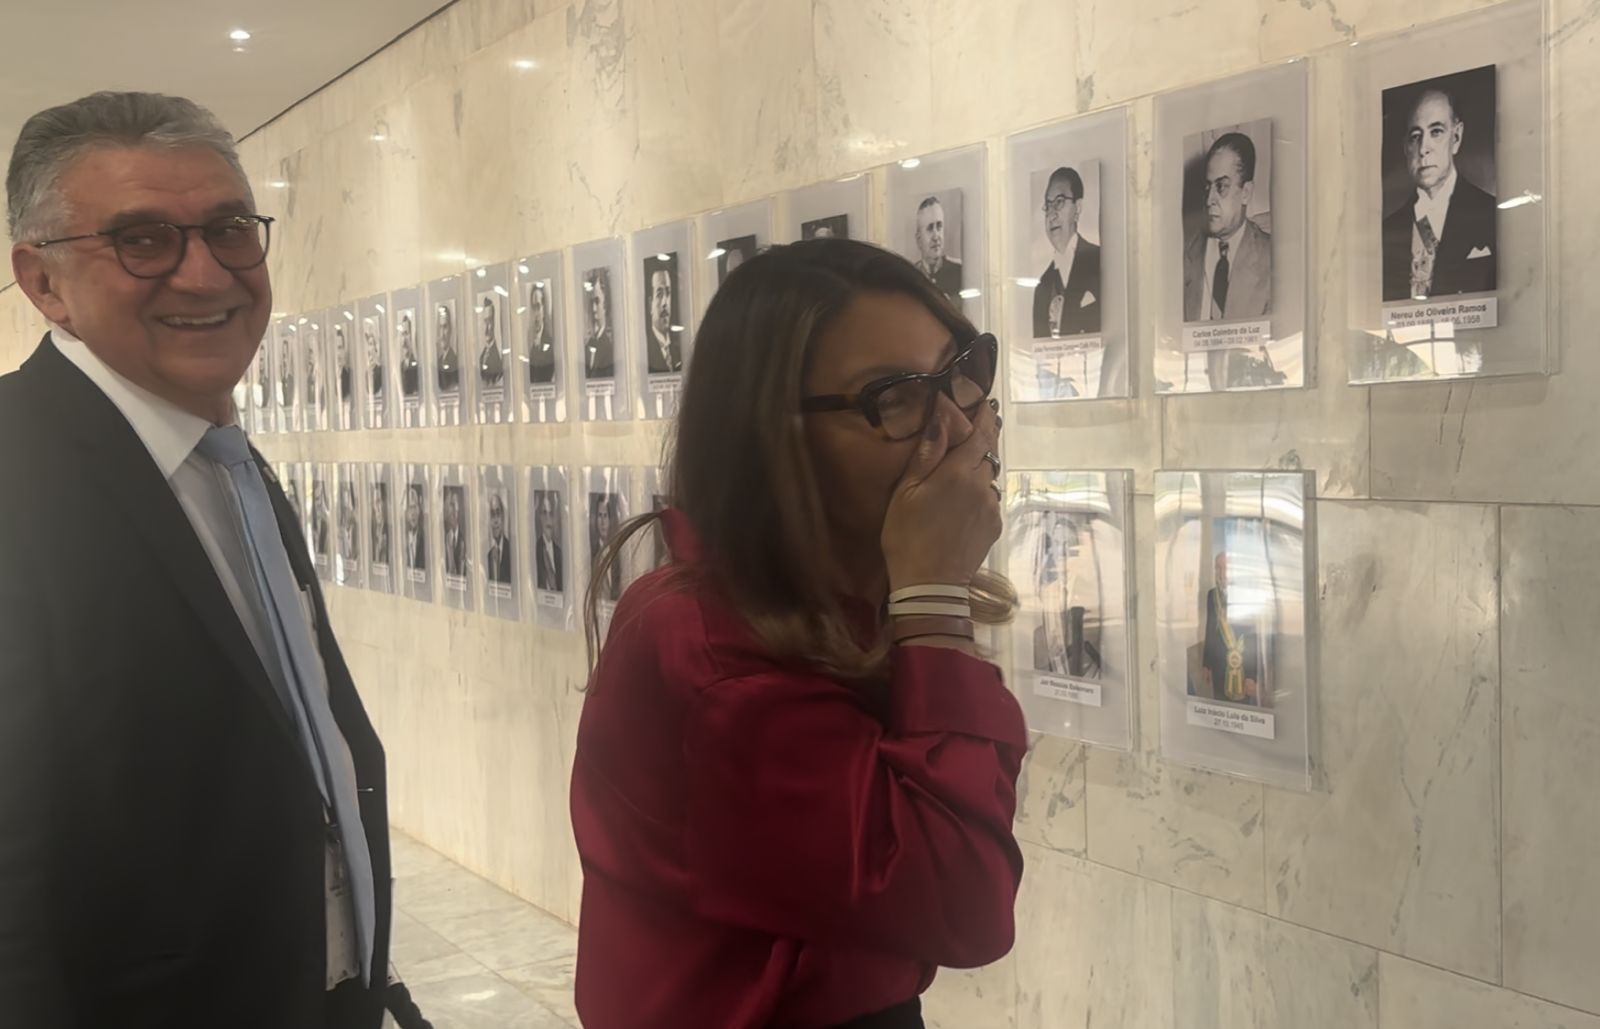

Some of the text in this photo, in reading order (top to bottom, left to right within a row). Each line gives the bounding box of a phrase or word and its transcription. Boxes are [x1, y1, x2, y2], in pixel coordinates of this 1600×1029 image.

[1391, 304, 1487, 320] Nereu de Oliveira Ramos
[1192, 330, 1211, 338] Carlos
[1212, 328, 1238, 336] Coimbra
[1248, 326, 1260, 334] Luz
